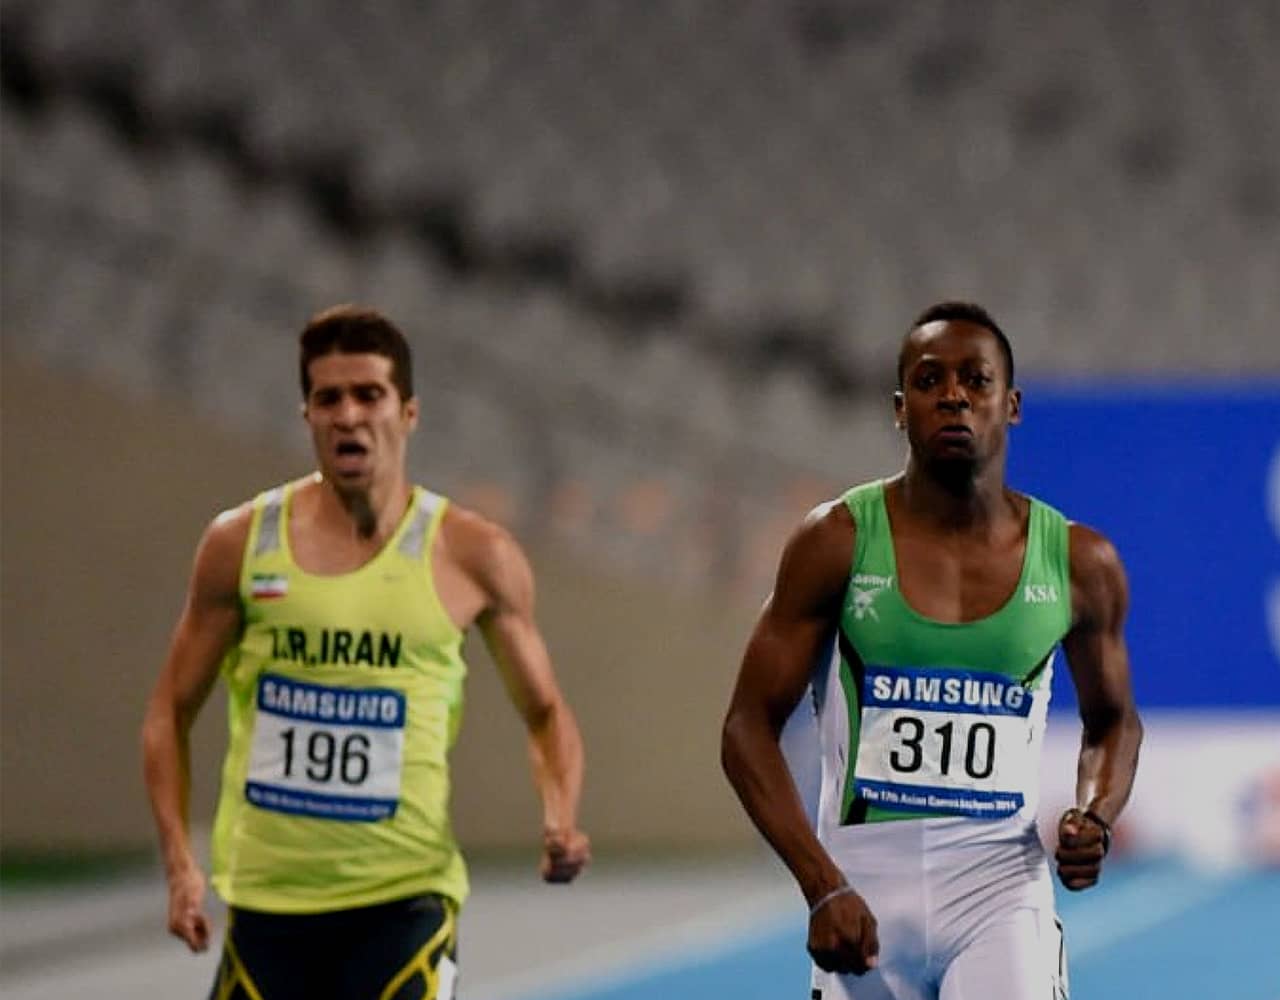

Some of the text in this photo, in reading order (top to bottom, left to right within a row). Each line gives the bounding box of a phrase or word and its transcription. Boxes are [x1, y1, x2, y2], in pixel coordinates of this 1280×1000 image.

[1024, 585, 1058, 603] KSA
[263, 681, 398, 723] SAMSUNG
[873, 675, 1024, 709] SAMSUNG
[280, 726, 371, 785] 196
[890, 716, 995, 779] 310
